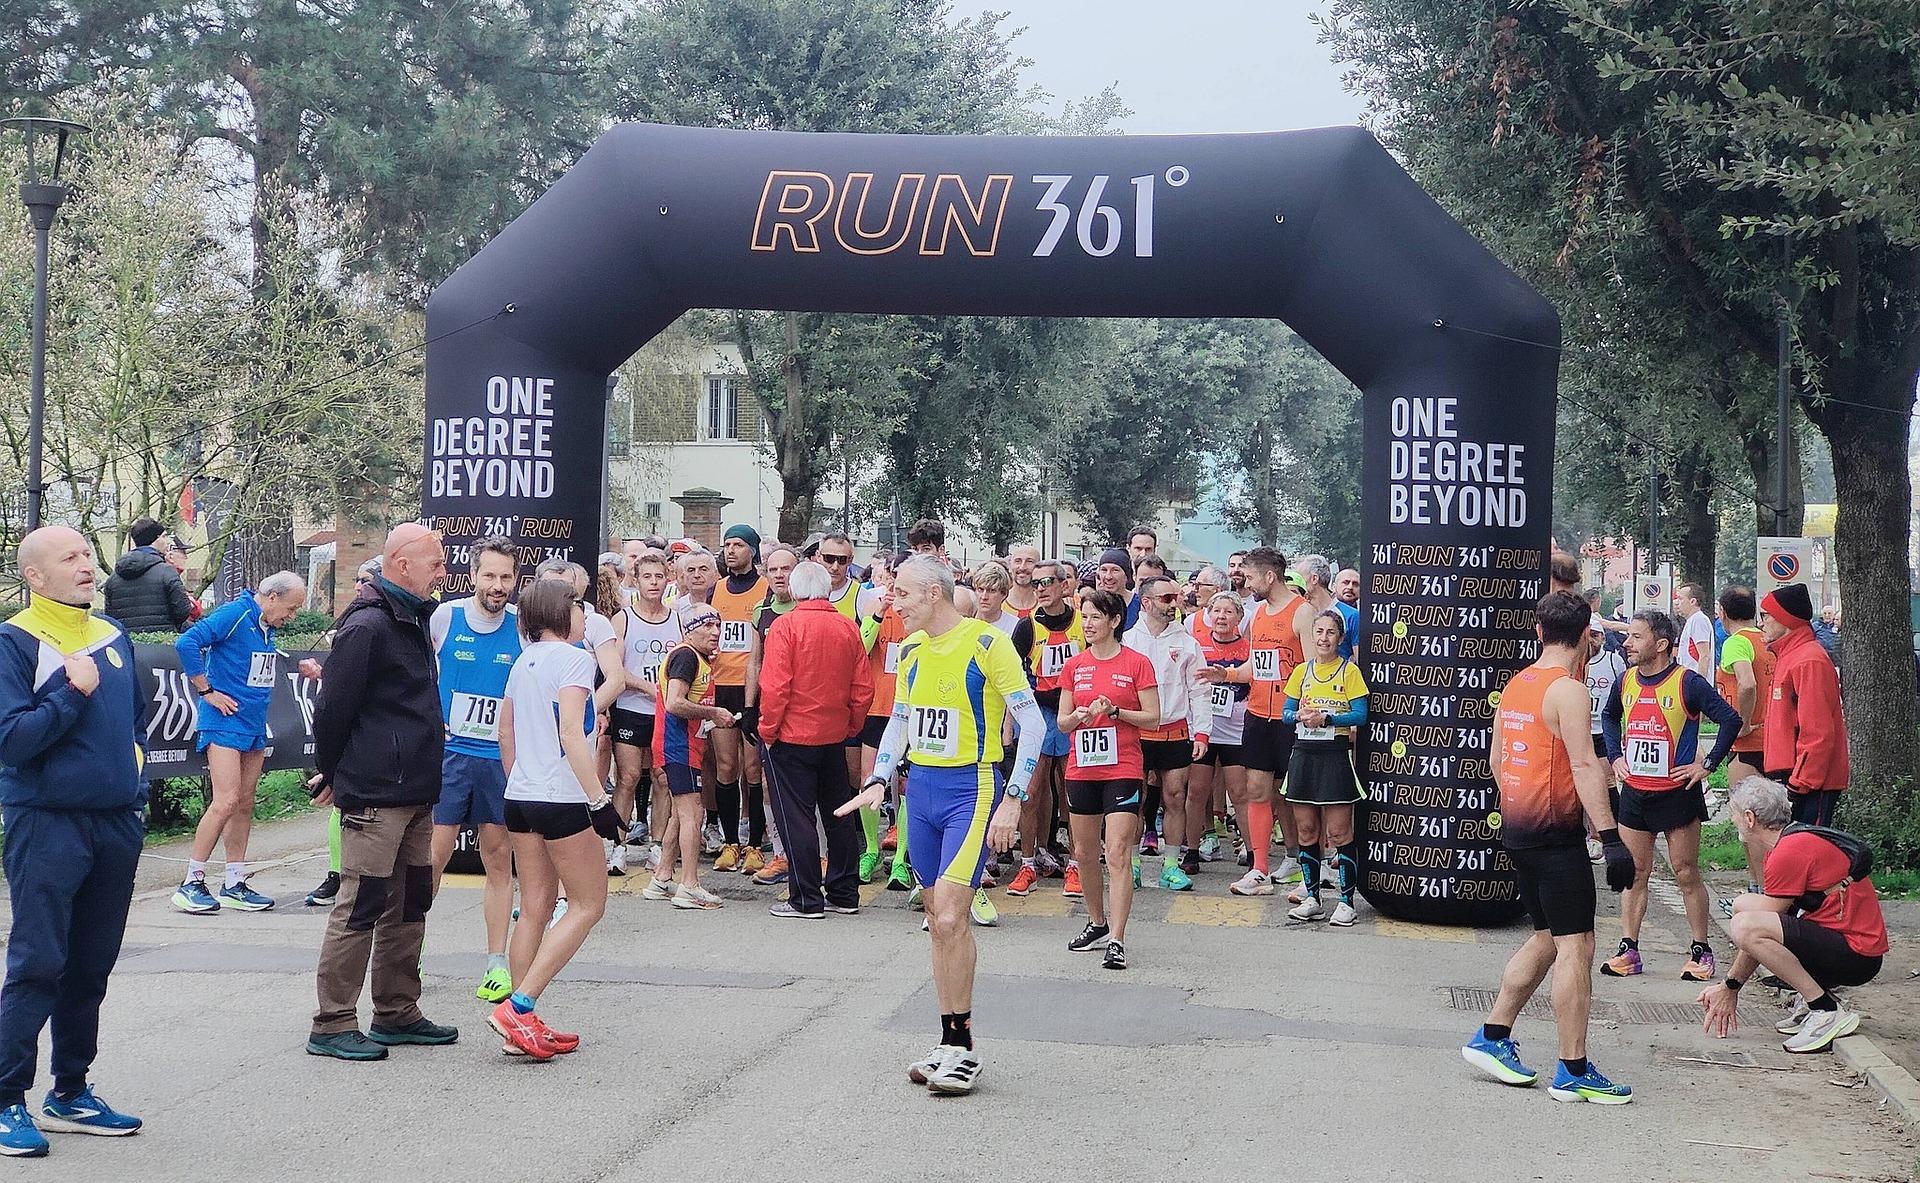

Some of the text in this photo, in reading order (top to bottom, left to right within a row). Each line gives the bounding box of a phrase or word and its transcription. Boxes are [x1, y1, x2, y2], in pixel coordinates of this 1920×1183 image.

[751, 165, 1190, 257] RUN 361°
[486, 376, 554, 416] ONE
[1391, 397, 1457, 437] ONE
[433, 417, 553, 457] DEGREE
[1391, 441, 1524, 484] DEGREE
[431, 459, 555, 498] BEYOND
[1390, 484, 1527, 527] BEYOND
[436, 517, 481, 536] RUN
[484, 515, 519, 536] 361°
[520, 518, 573, 539] RUN
[1372, 542, 1541, 570] 361° RUN 361° RUN
[1371, 574, 1417, 595] RUN
[1421, 575, 1457, 596] 361°
[1459, 577, 1516, 599] RUN
[1371, 602, 1396, 624] 361°
[1397, 605, 1454, 627] RUN
[1457, 606, 1494, 628] 361°
[725, 622, 744, 641] 541
[1050, 644, 1072, 665] 714
[1254, 651, 1273, 669] 527
[1371, 634, 1417, 655] RUN
[1420, 635, 1457, 657] 361°
[1458, 638, 1516, 659] RUN
[643, 665, 661, 684] 51
[1370, 661, 1396, 683] 361°
[1395, 665, 1453, 687] RUN
[1457, 666, 1493, 689] 361°
[1212, 687, 1228, 706] 59
[1370, 692, 1416, 715] RUN
[1419, 695, 1456, 717] 361°
[1458, 698, 1496, 719] RU
[465, 697, 497, 725] 713
[916, 708, 948, 739] 723
[1082, 730, 1108, 753] 675
[1370, 721, 1493, 749] 361° RUN 361°
[1369, 752, 1416, 775] RUN
[1419, 755, 1456, 777] 361°
[1457, 758, 1494, 779] RU
[1634, 741, 1660, 763] 735
[1368, 781, 1493, 810] 361° RUN 361°
[1368, 811, 1502, 840] RUN 361° RU
[1367, 840, 1394, 863] 361°
[1393, 844, 1453, 868] RUN
[1456, 848, 1493, 870] 361°
[1368, 871, 1415, 895] RUN
[1418, 876, 1456, 898] 361°
[1457, 879, 1514, 901] RUN
